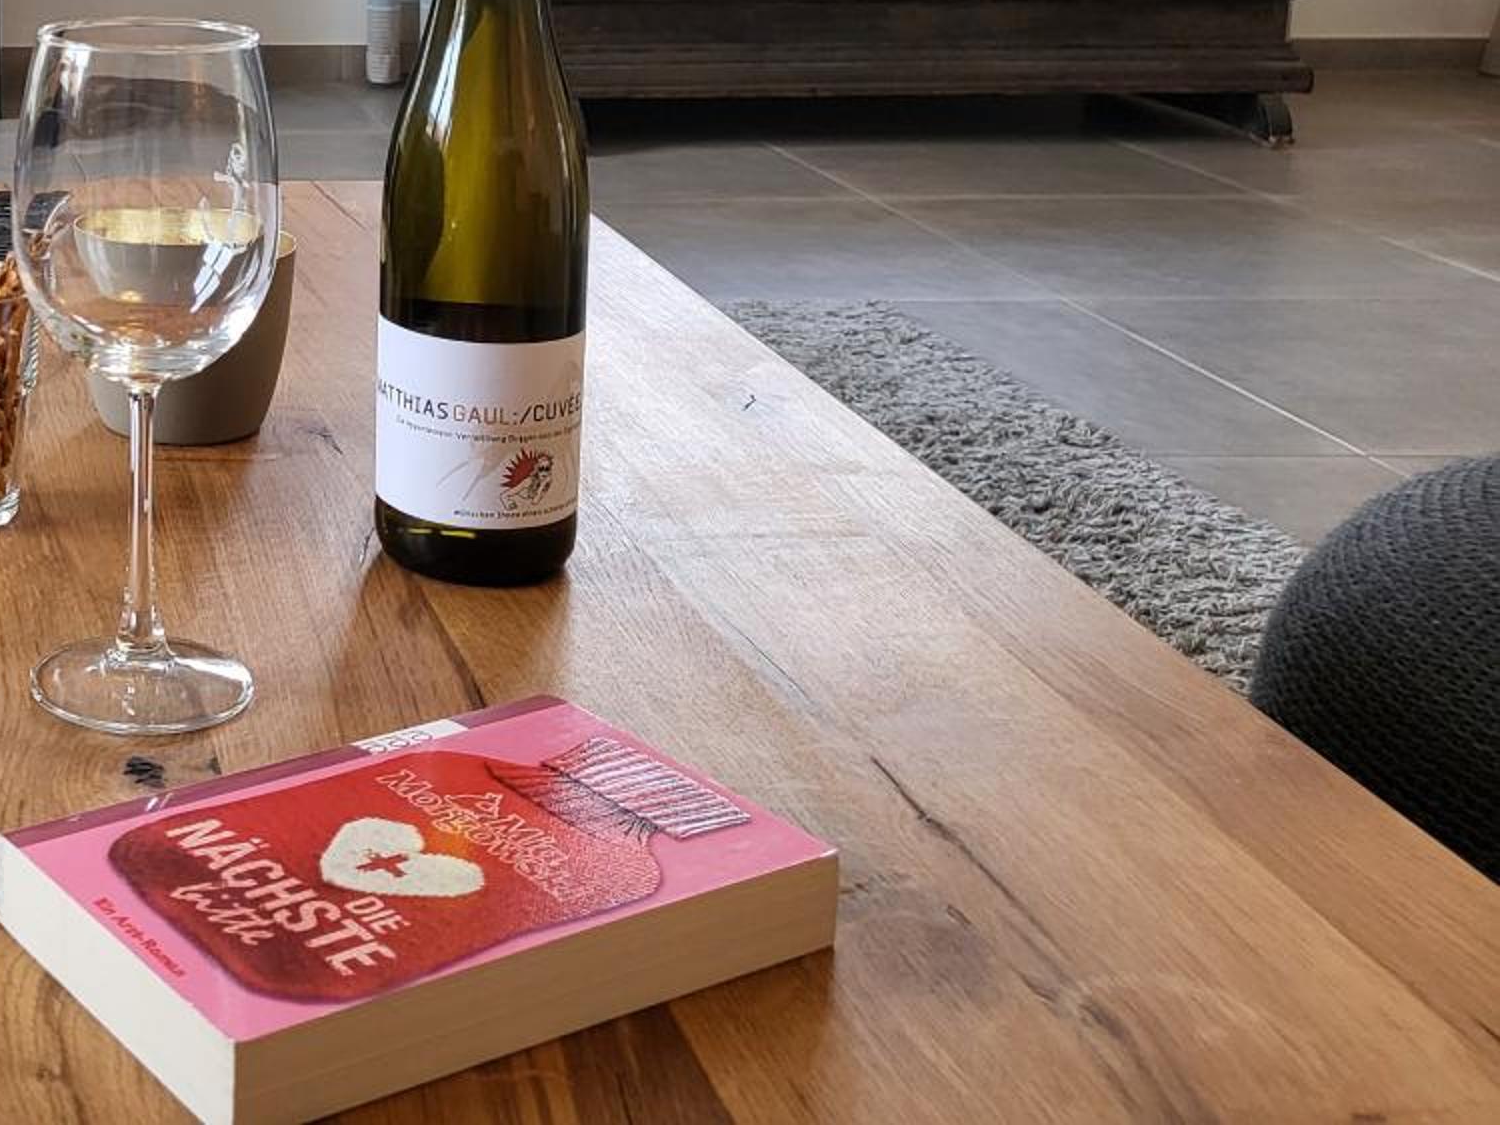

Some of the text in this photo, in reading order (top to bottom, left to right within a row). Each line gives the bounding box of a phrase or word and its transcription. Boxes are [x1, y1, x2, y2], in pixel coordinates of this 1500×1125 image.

[165, 817, 397, 977] NÄCHSTE
[169, 881, 276, 946] bitte
[344, 895, 412, 935] DIE
